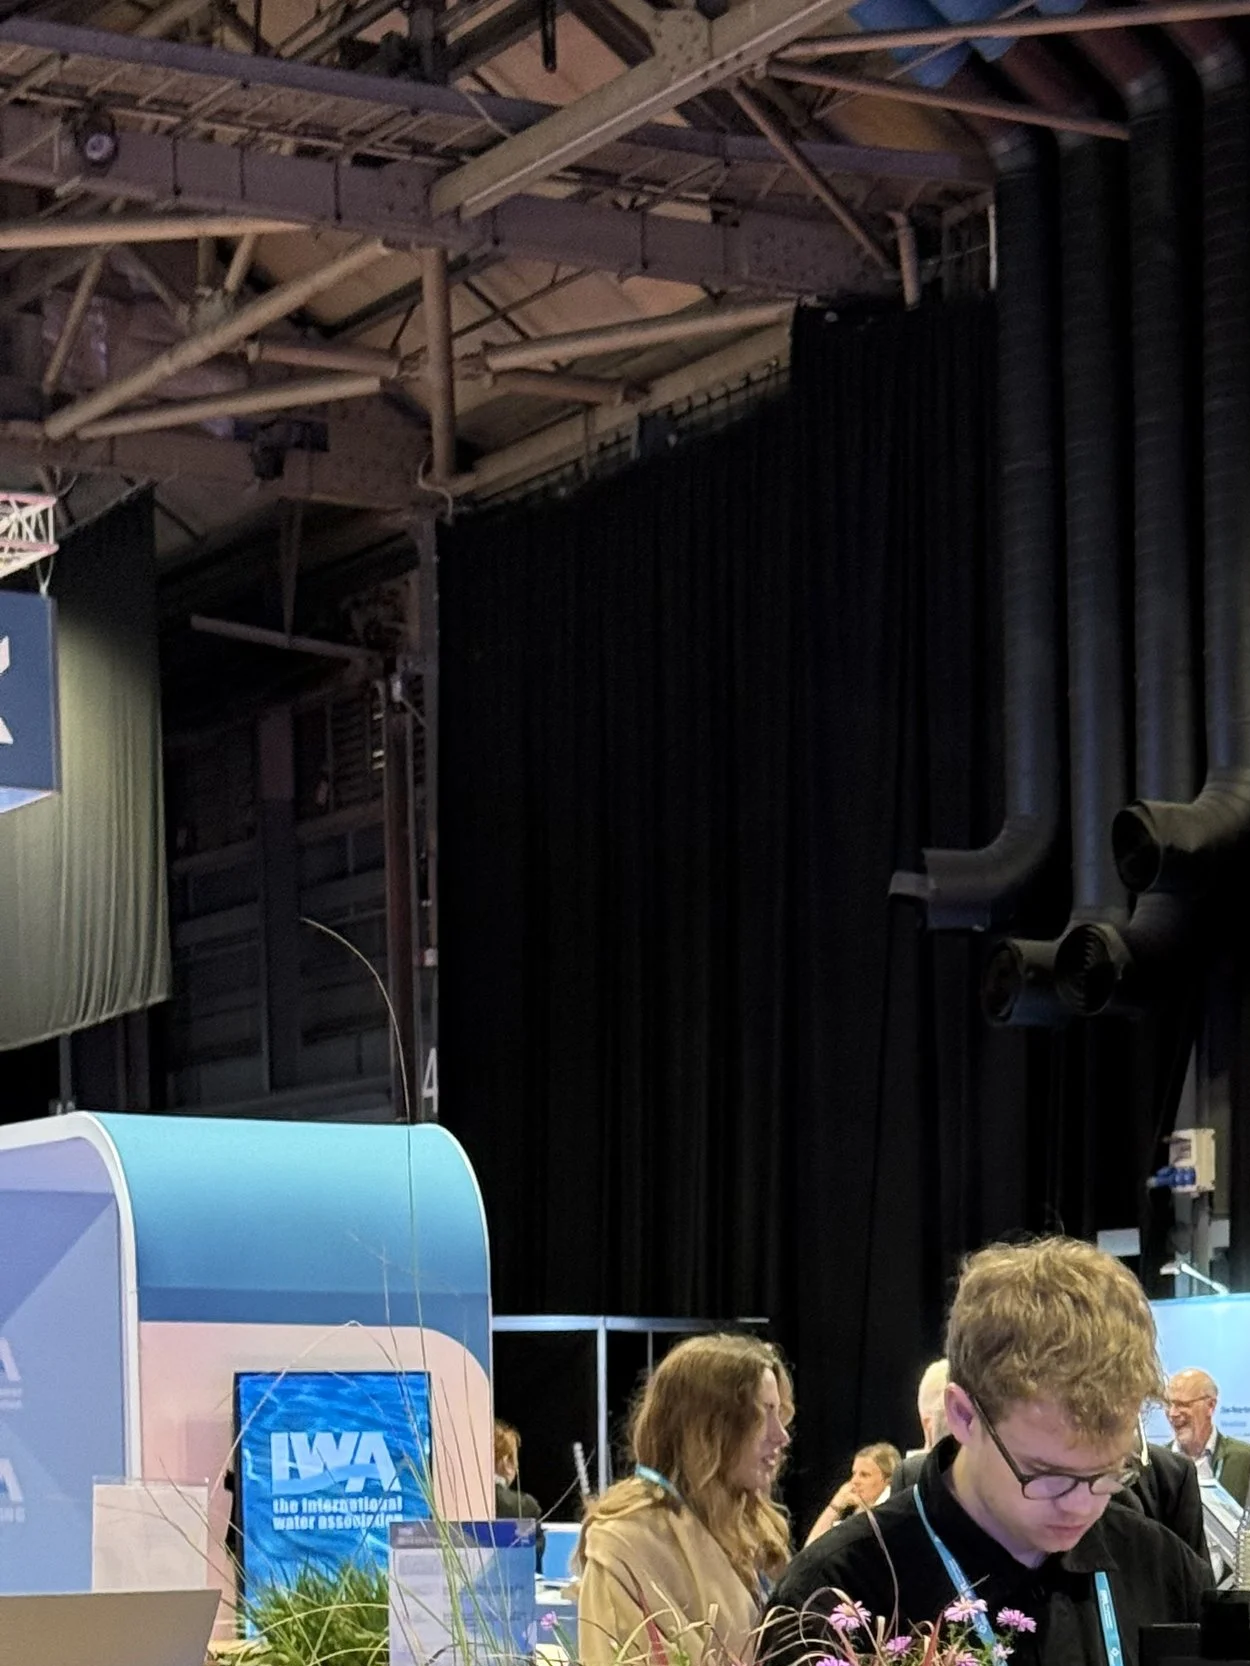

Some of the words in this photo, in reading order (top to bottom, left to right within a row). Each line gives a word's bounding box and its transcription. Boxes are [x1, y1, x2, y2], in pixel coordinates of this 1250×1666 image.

[270, 1432, 403, 1495] IWA
[273, 1498, 299, 1514] the
[302, 1495, 403, 1514] international
[273, 1515, 315, 1530] water
